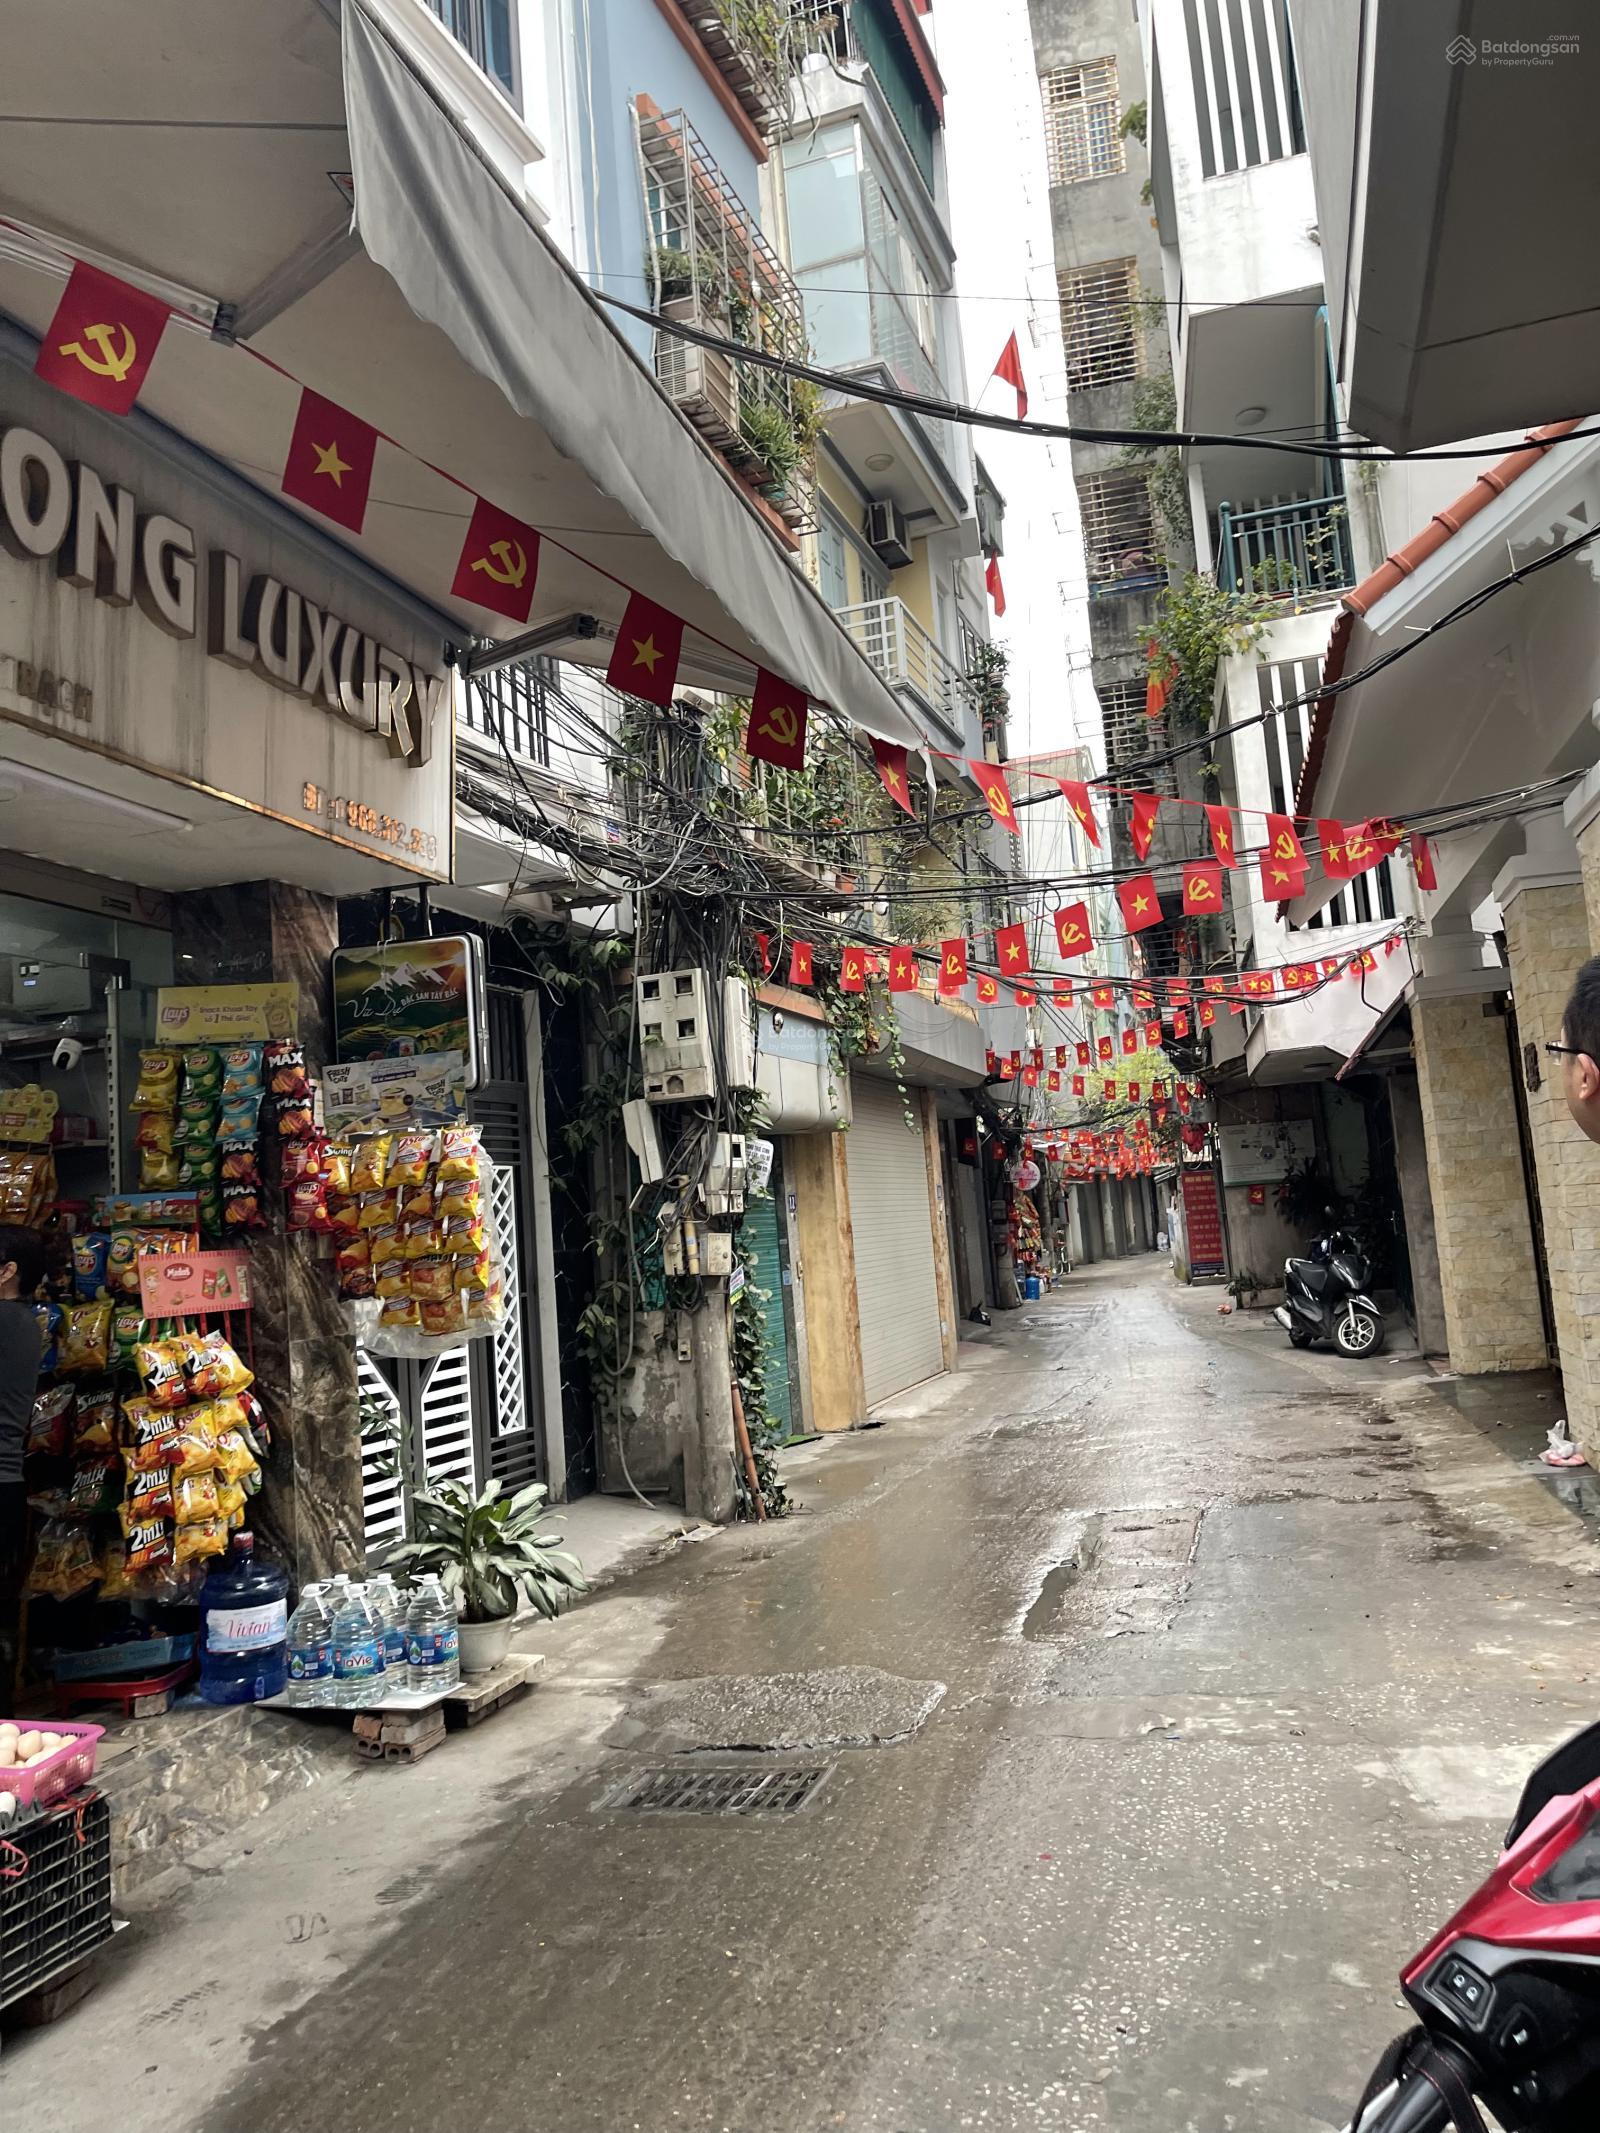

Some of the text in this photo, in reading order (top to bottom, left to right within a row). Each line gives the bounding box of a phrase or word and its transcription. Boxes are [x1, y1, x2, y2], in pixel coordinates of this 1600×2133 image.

[208, 549, 445, 769] LUXURY
[268, 1051, 304, 1068] MAX
[222, 1140, 255, 1152] MAX
[321, 1143, 354, 1158] Swing
[223, 1184, 257, 1198] MAX
[77, 1391, 115, 1412] Swing
[226, 1618, 272, 1640] Vivian
